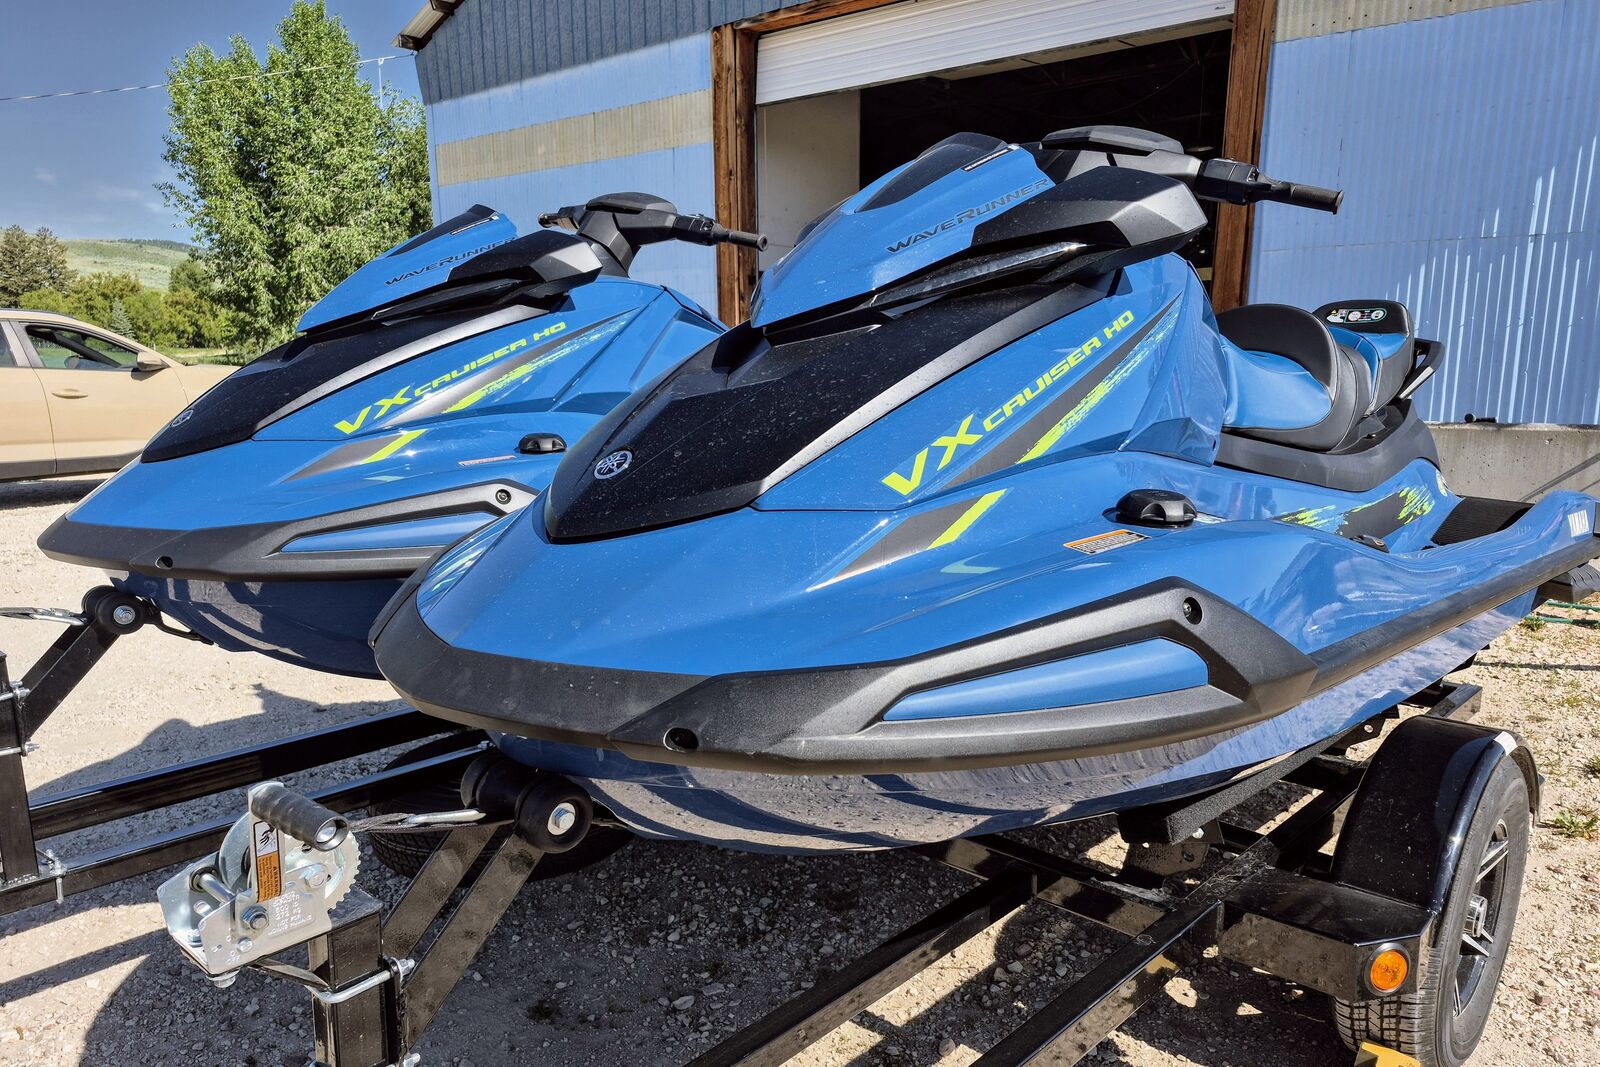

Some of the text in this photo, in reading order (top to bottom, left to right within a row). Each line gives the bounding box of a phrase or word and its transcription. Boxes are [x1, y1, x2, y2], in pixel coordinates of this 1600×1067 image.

[334, 321, 566, 435] VX CRUISER HO
[881, 310, 1135, 496] VX CRUISER HO
